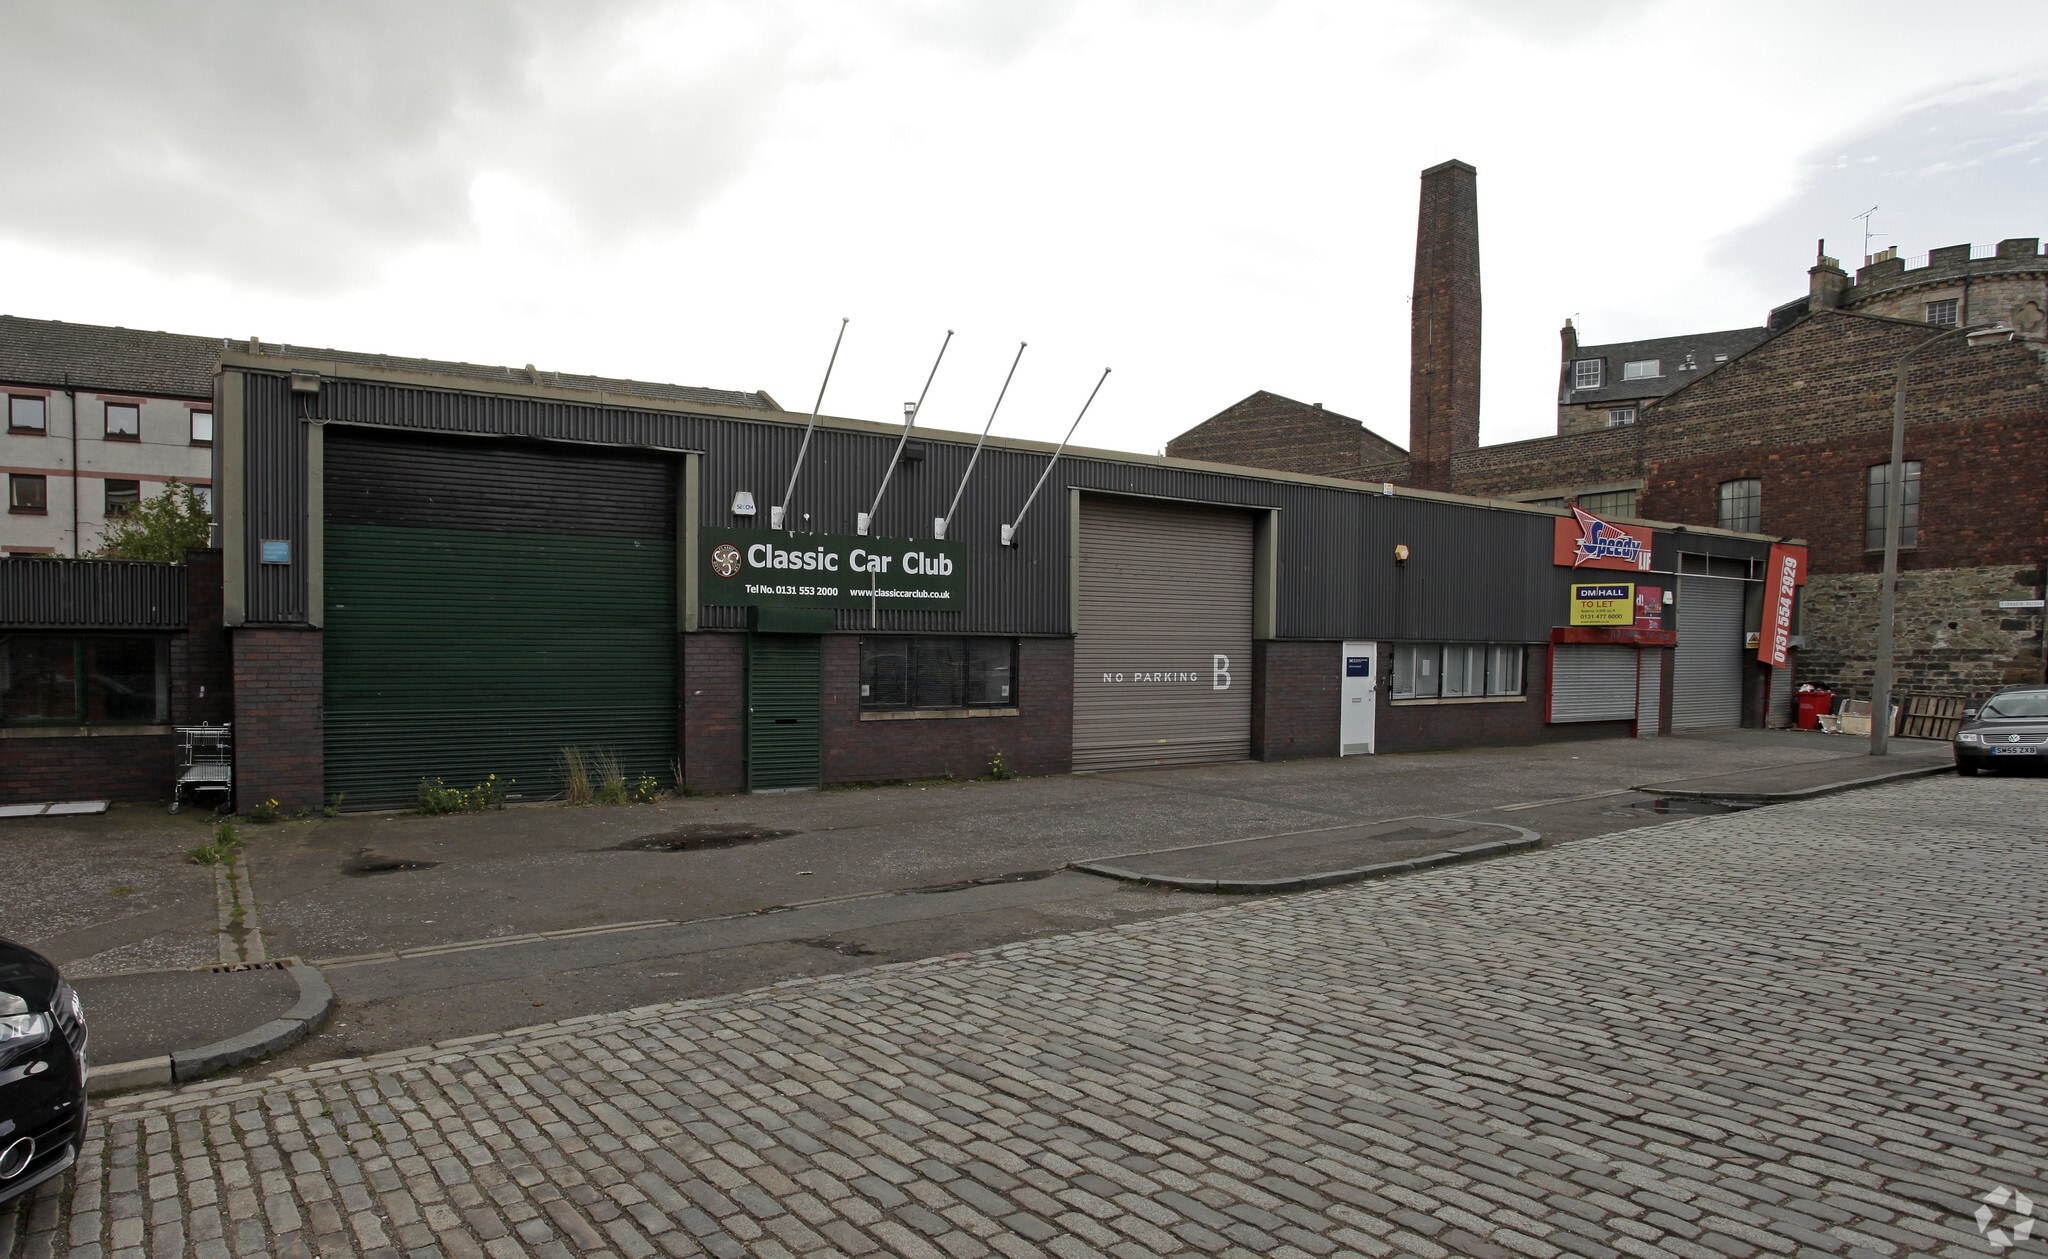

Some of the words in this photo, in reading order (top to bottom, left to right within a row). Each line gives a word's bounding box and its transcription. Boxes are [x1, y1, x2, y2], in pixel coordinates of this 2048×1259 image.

[1583, 521, 1641, 562] Speedy
[747, 543, 839, 572] Classic
[849, 548, 892, 573] Car
[902, 551, 953, 576] Club
[745, 584, 759, 594] Tel
[760, 585, 775, 594] No.
[775, 585, 797, 595] 0131
[798, 586, 815, 596] 553
[816, 587, 839, 597] 2000
[1781, 557, 1797, 597] 2929
[849, 588, 951, 599] wwwclassiccarclub.co.uk
[1596, 600, 1614, 608] LET
[1778, 596, 1792, 627] 554
[1774, 627, 1788, 663] 0131
[1103, 672, 1124, 683] NO
[1134, 672, 1198, 682] PARKING
[1212, 654, 1232, 690] B
